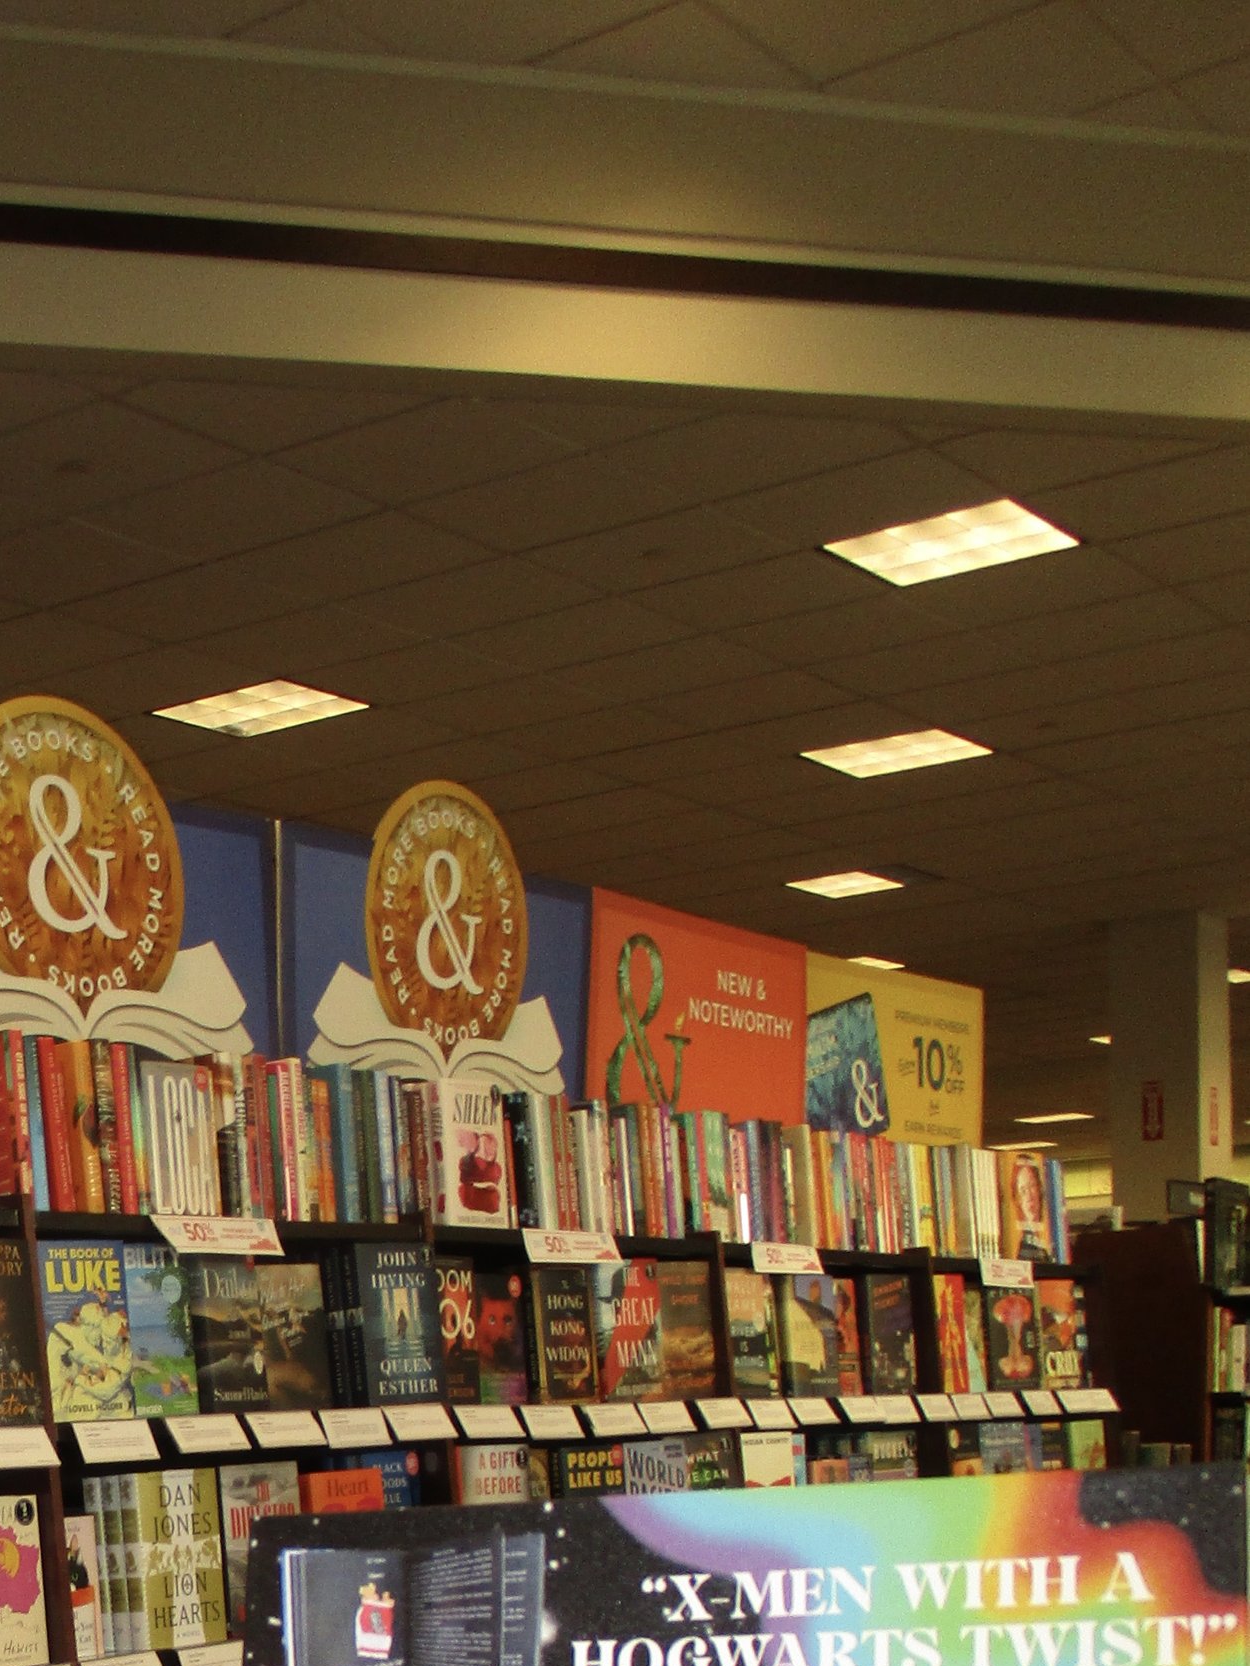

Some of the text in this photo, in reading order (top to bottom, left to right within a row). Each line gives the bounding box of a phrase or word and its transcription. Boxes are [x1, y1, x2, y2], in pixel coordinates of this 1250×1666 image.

[13, 729, 94, 763] BOOKS
[48, 783, 164, 997] READ MORE BOOKS
[382, 809, 476, 1004] READ MORE BOOKS
[481, 949, 512, 1022] MORE
[717, 969, 767, 1000] NEW &
[423, 1017, 480, 1045] BOOKS
[688, 997, 794, 1040] NOTEWORTHY
[47, 1247, 114, 1259] THE BOOK OF
[377, 1251, 417, 1268] JOHN
[45, 1260, 121, 1293] LUKE
[372, 1272, 425, 1289] IRVING
[623, 1266, 640, 1288] THE
[547, 1295, 583, 1310] HONG
[611, 1297, 656, 1328] GREAT
[551, 1320, 584, 1336] KONG
[380, 1358, 432, 1376] QUEEN
[546, 1347, 589, 1362] WIDOW
[617, 1342, 658, 1367] MANN
[378, 1378, 439, 1395] ESTHER
[158, 1483, 202, 1508] DAN
[153, 1512, 212, 1544] JONES
[164, 1571, 208, 1599] LION
[897, 1554, 1081, 1614] WITH
[1104, 1551, 1155, 1601] A
[154, 1600, 221, 1630] HEARTS
